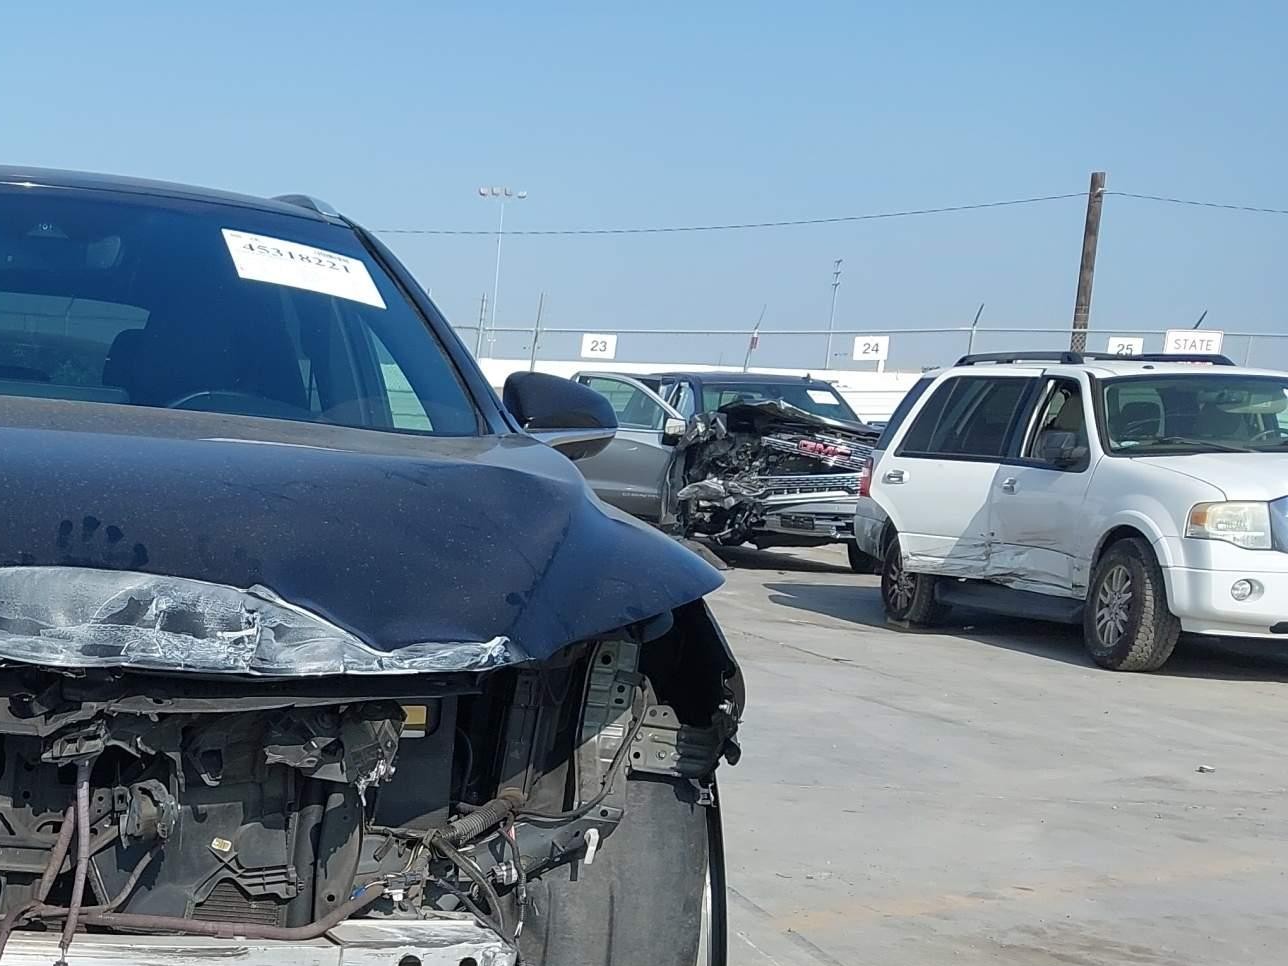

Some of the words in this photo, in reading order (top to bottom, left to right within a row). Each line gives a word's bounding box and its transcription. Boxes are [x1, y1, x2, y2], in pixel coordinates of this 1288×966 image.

[242, 243, 351, 274] 45318221
[590, 340, 608, 352] 23
[862, 342, 880, 354] 24
[1116, 343, 1133, 356] 25
[1174, 339, 1214, 351] STATE
